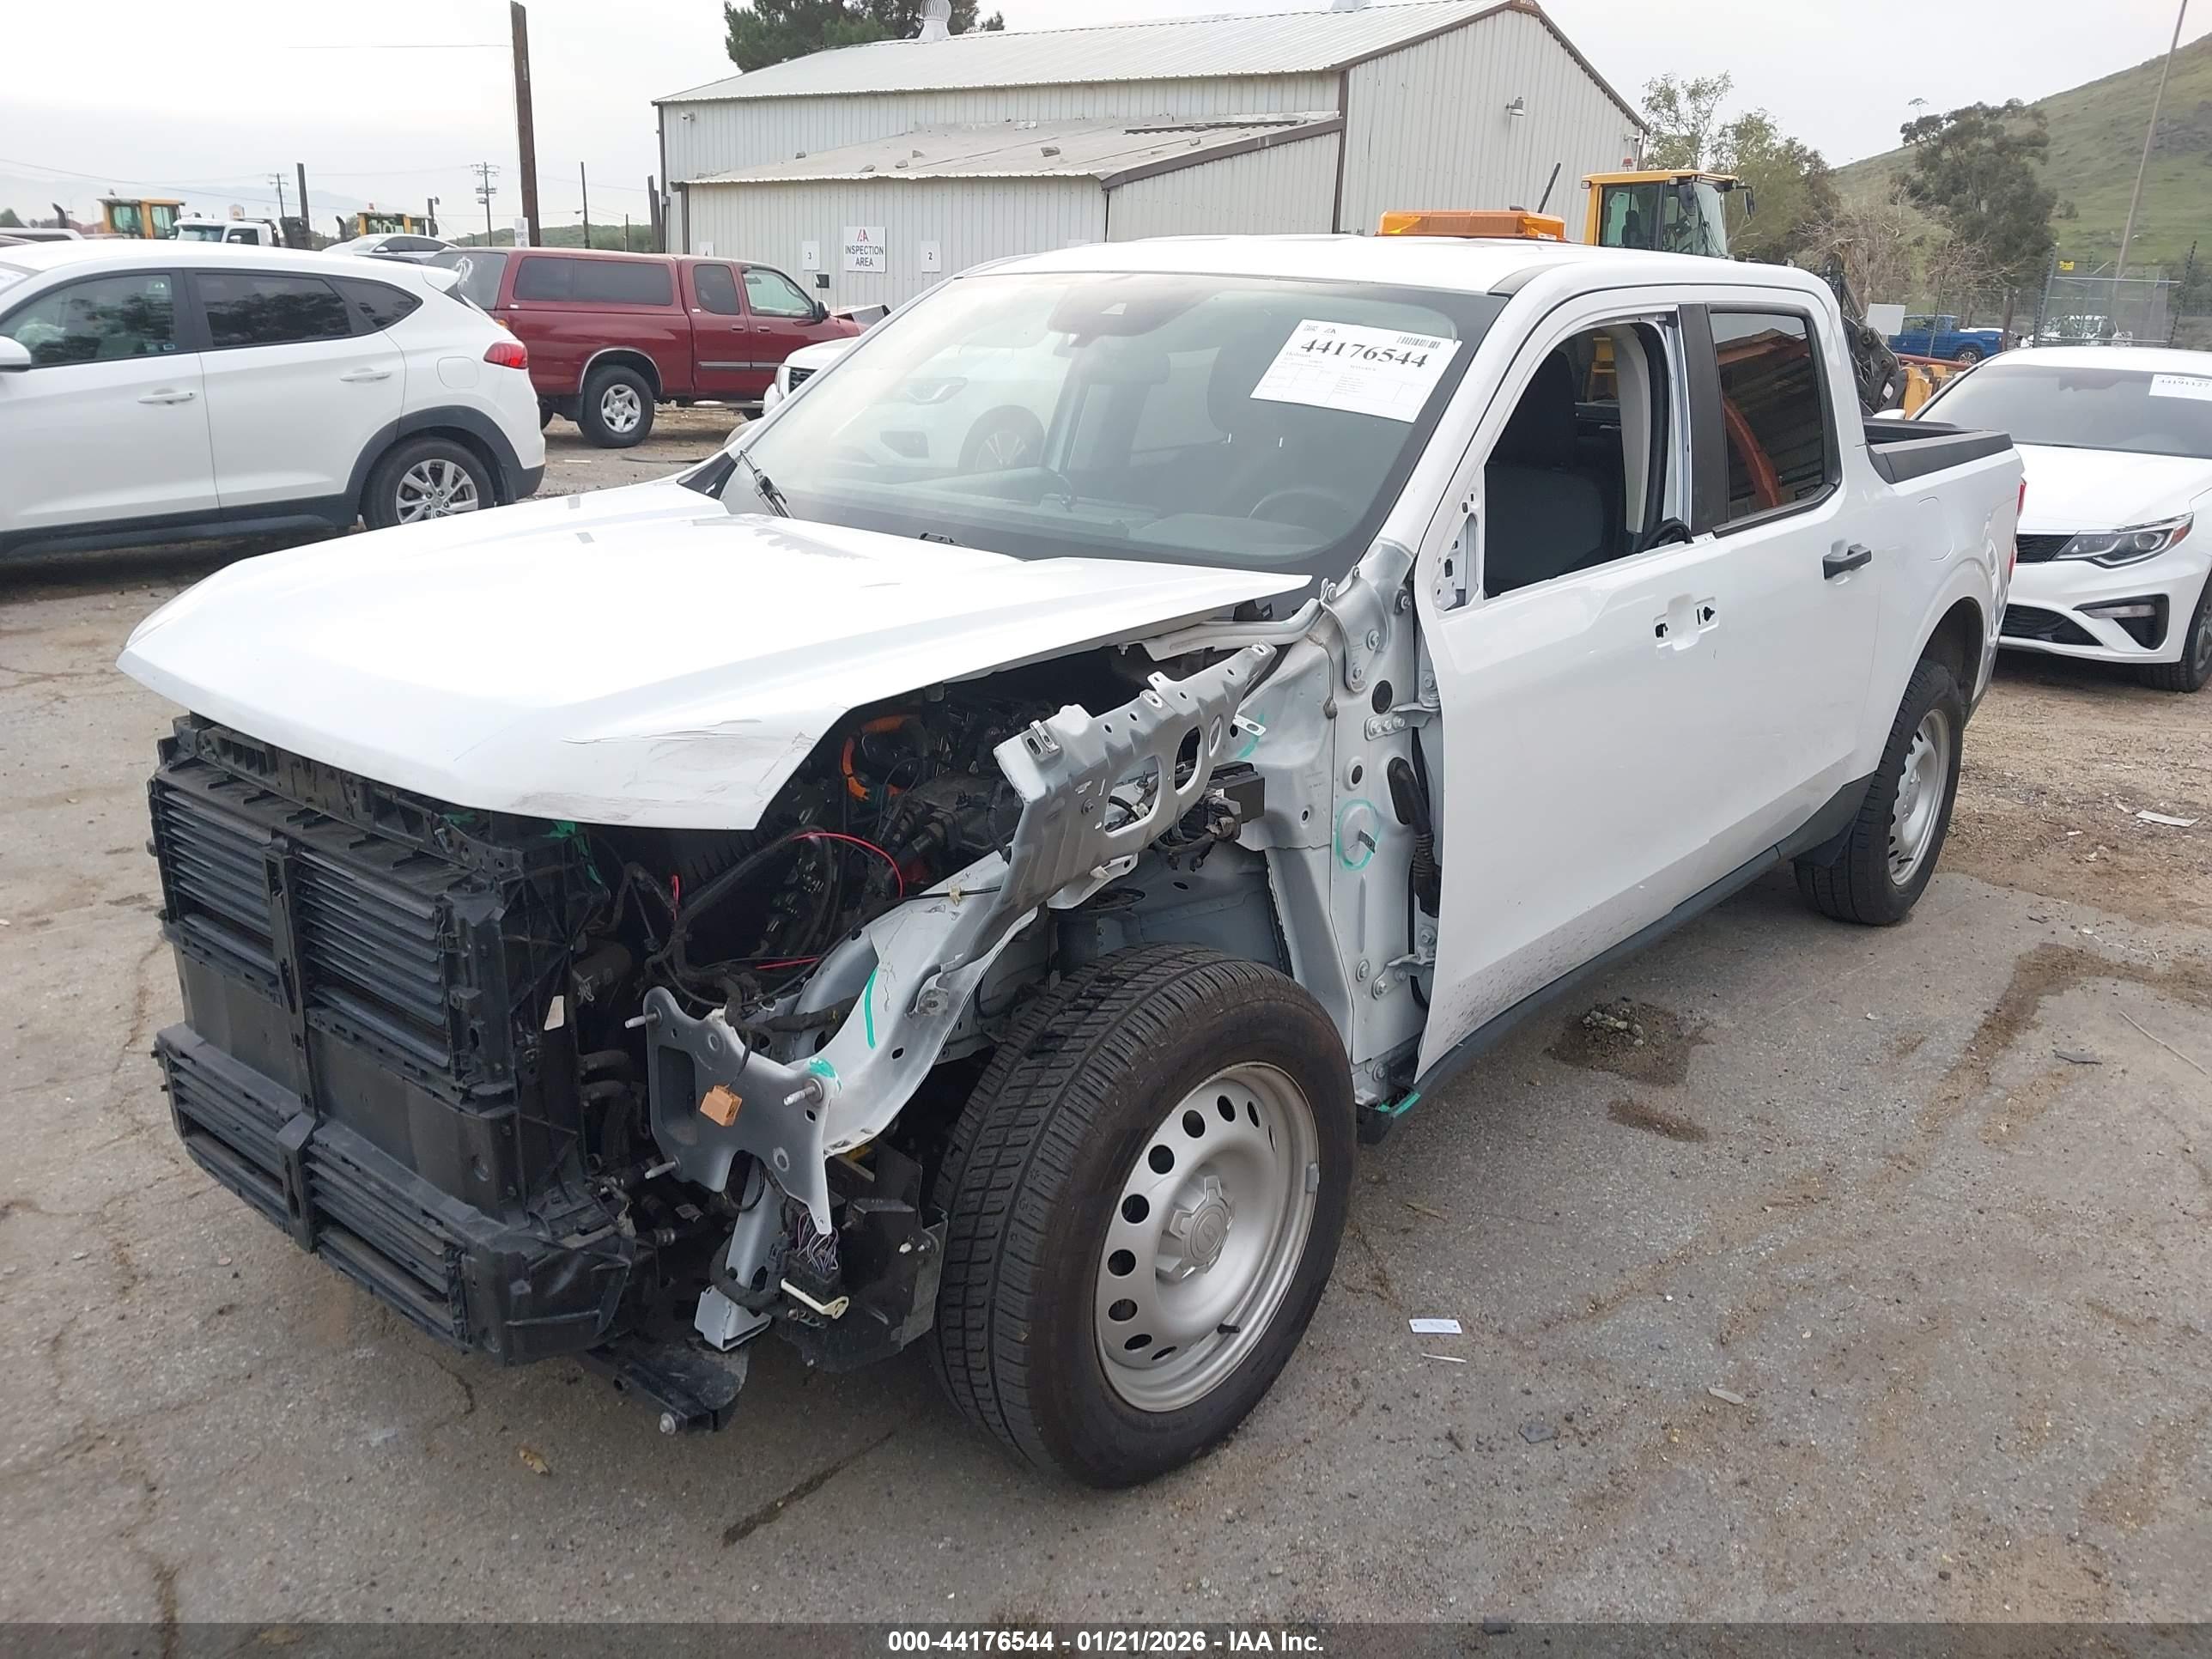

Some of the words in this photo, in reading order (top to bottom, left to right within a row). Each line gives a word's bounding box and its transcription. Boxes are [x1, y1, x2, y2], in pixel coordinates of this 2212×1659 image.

[845, 246, 884, 255] INSPECTION
[807, 252, 812, 260] 3
[927, 252, 933, 260] 2
[855, 257, 874, 267] AREA
[1301, 338, 1428, 368] 44176544
